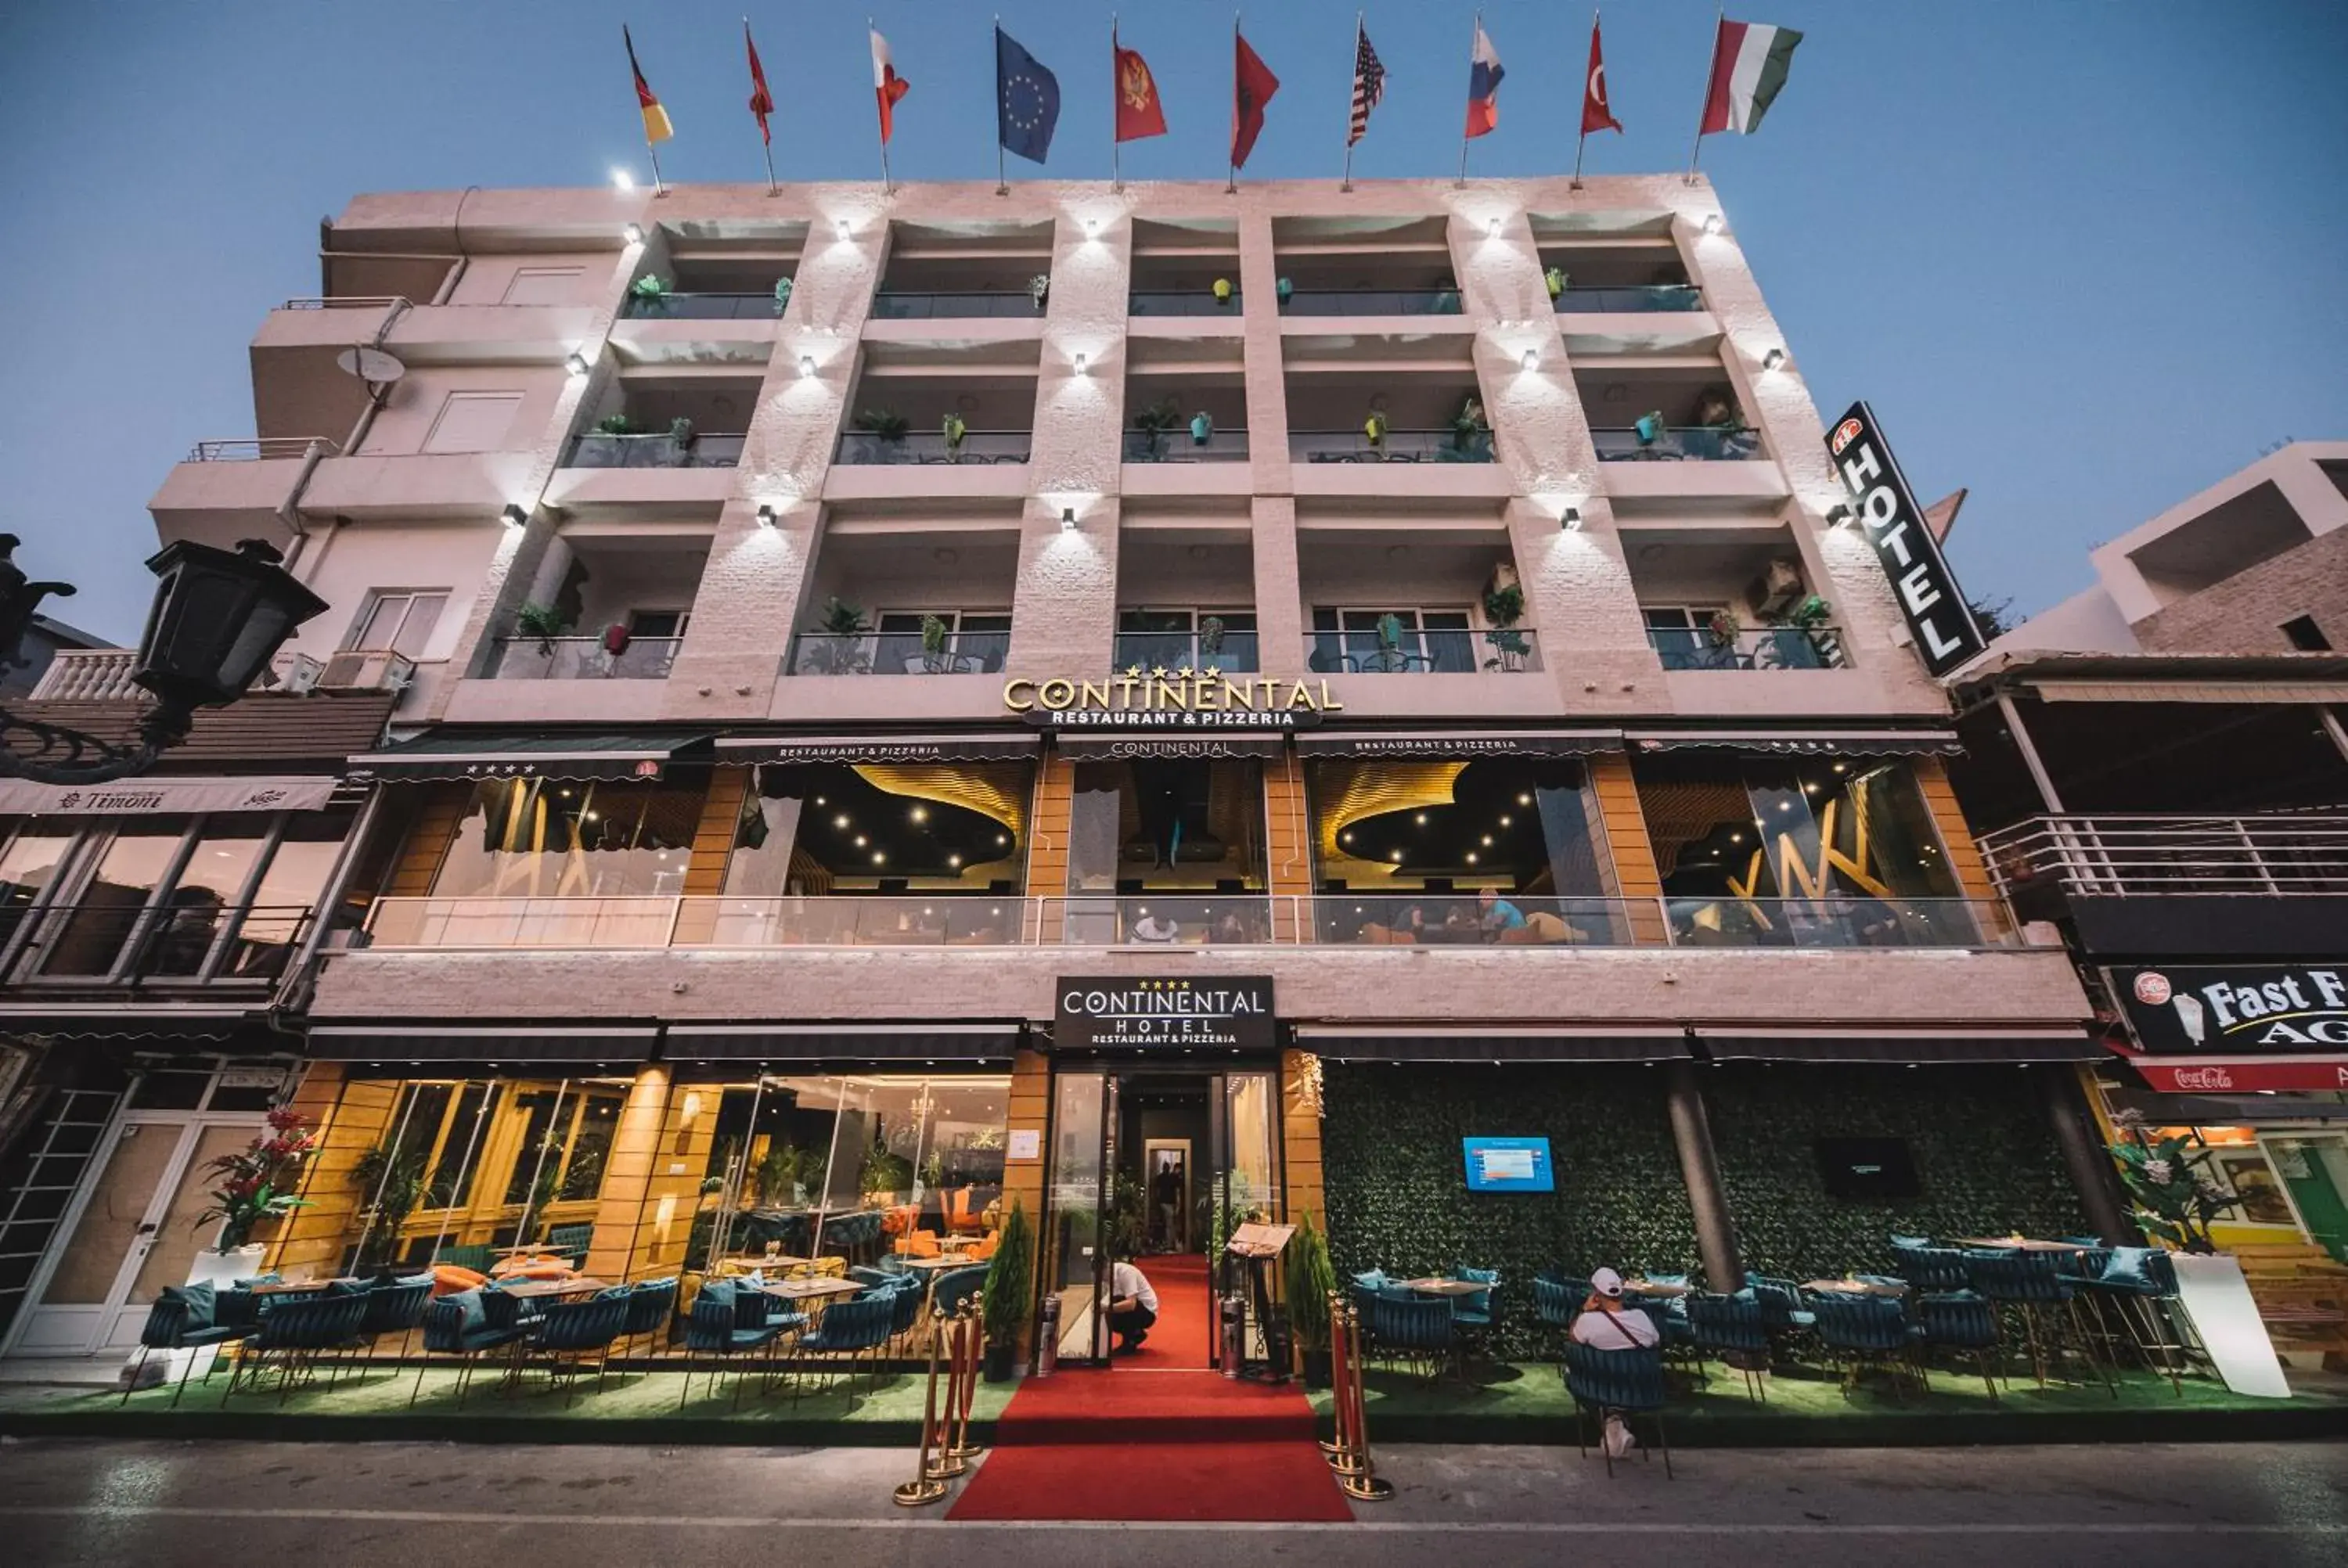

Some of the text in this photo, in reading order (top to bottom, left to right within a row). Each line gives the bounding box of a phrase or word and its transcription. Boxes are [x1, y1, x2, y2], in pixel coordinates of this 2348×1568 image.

[1843, 442, 1961, 661] HOTEL
[1003, 678, 1345, 712] CONTINENTAL
[1053, 711, 1294, 725] RESTAURANT & PIZZERIA
[780, 747, 865, 757] RESTAURANT
[879, 746, 939, 755] PIZZERIA
[1111, 743, 1231, 754] CONTINENTAL
[1064, 991, 1265, 1013] CONTINENTAL
[2202, 976, 2311, 1027] Fast
[1116, 1020, 1212, 1033] HOTEL
[1092, 1035, 1169, 1044] RESTAURANT
[1182, 1035, 1237, 1044] PIZZERIA
